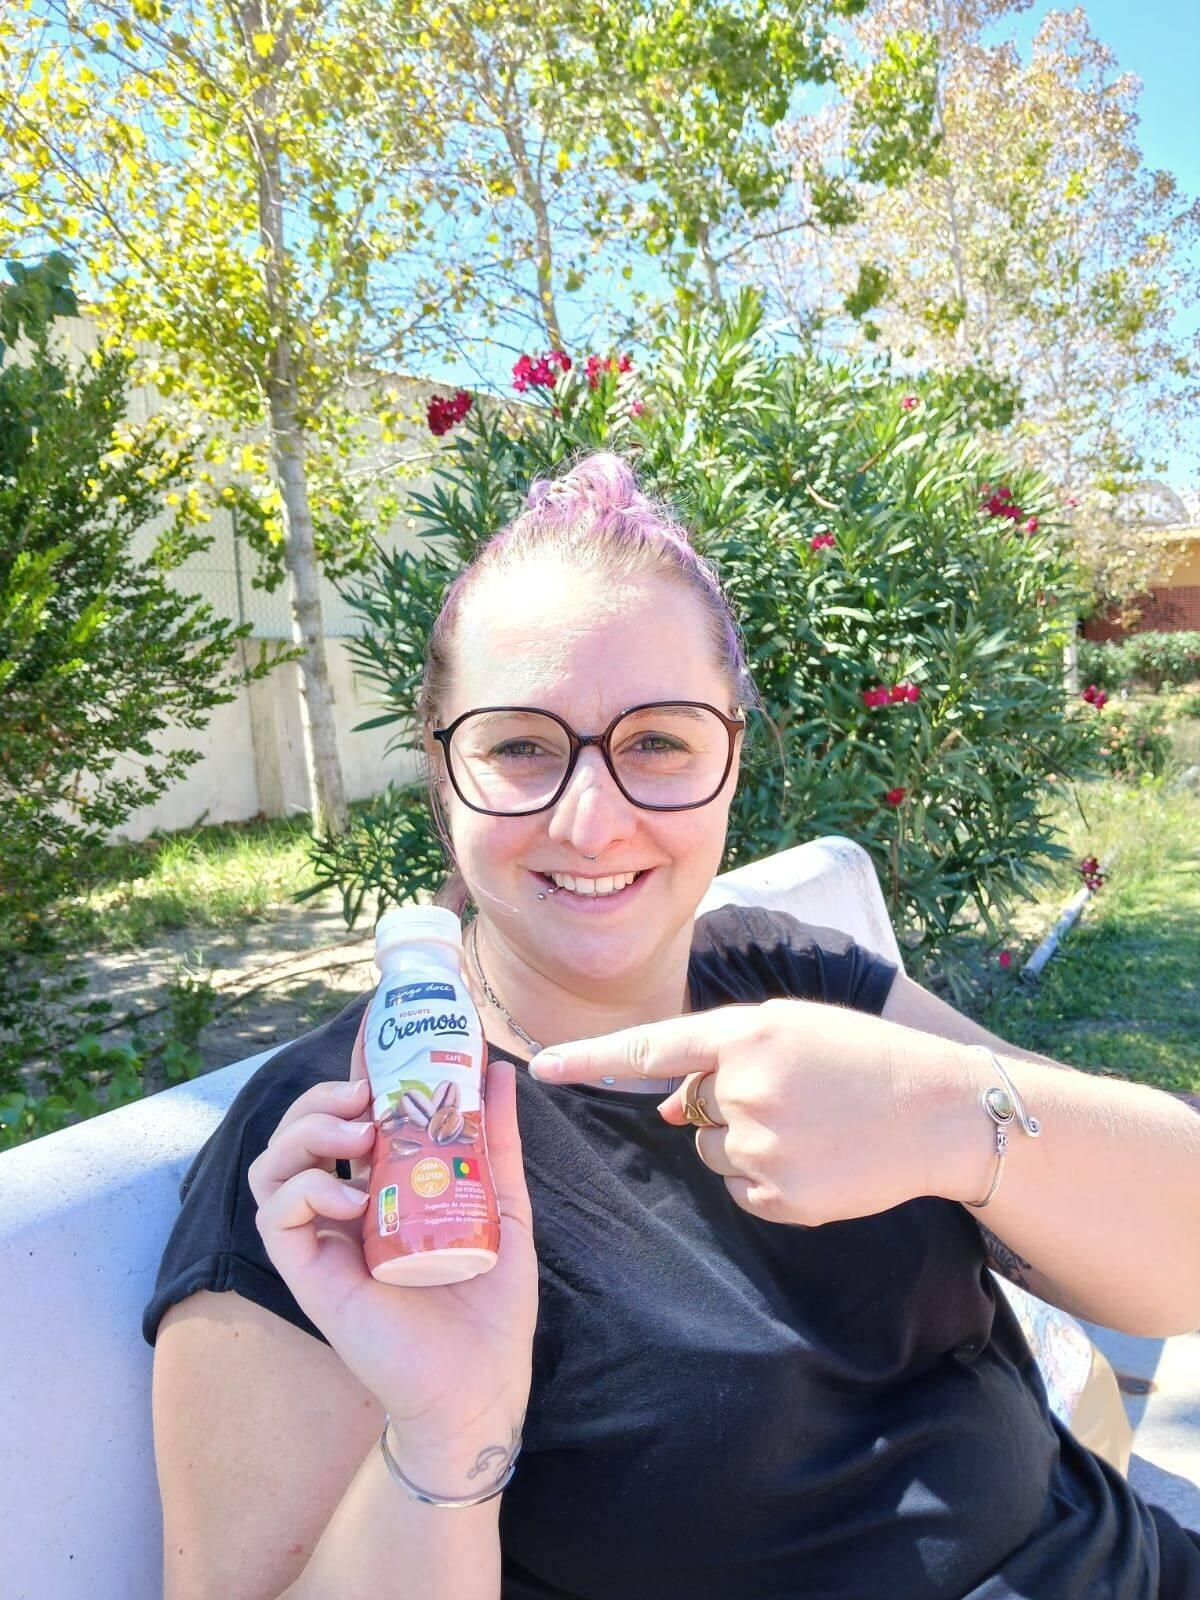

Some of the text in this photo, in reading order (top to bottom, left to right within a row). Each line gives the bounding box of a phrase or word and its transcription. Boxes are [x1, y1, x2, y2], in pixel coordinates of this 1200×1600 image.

[426, 983, 453, 992] doce
[399, 1008, 431, 1018] IOGURTE
[378, 1013, 469, 1051] Cremoso
[421, 1162, 438, 1170] SEM
[416, 1172, 444, 1181] GLUTEN
